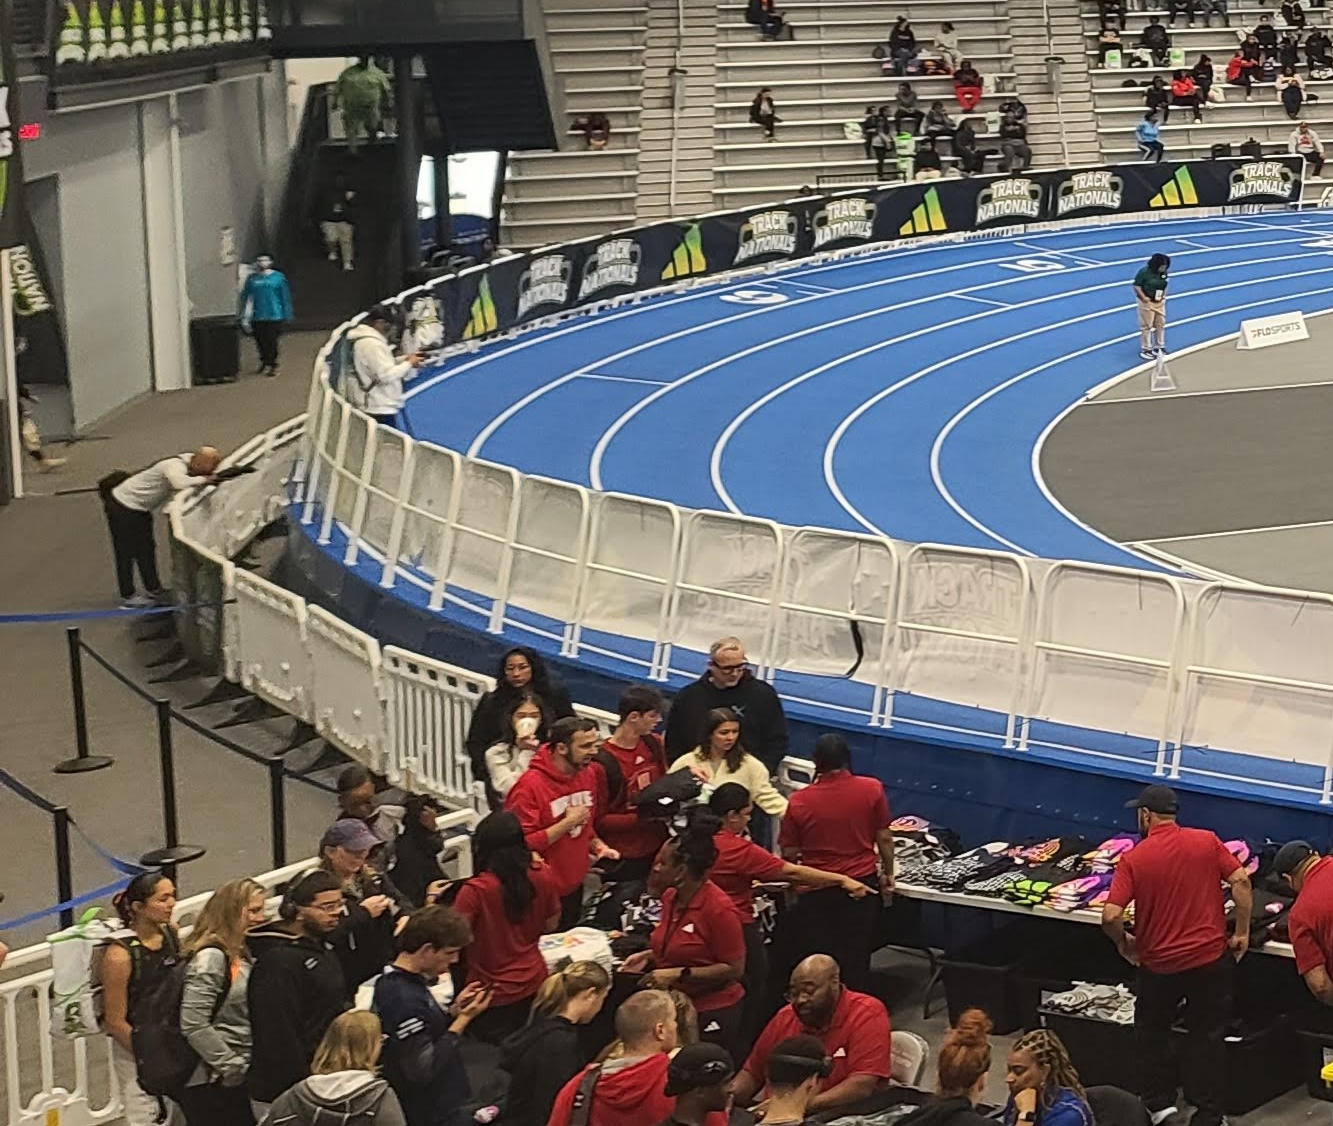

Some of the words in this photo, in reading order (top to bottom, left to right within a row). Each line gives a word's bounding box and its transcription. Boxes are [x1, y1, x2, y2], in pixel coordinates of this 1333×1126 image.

[1071, 171, 1111, 191] TRACK
[1242, 160, 1281, 178] TRACK
[990, 178, 1030, 198] TRACK
[1229, 178, 1293, 201] NATIONALS
[825, 198, 867, 220] TRACK
[975, 198, 1040, 225] NATIONALS
[1056, 191, 1121, 217] NATIONALS
[749, 210, 790, 236] TRACK
[813, 219, 874, 251] NATIONALS
[733, 234, 797, 266] NATIONALS
